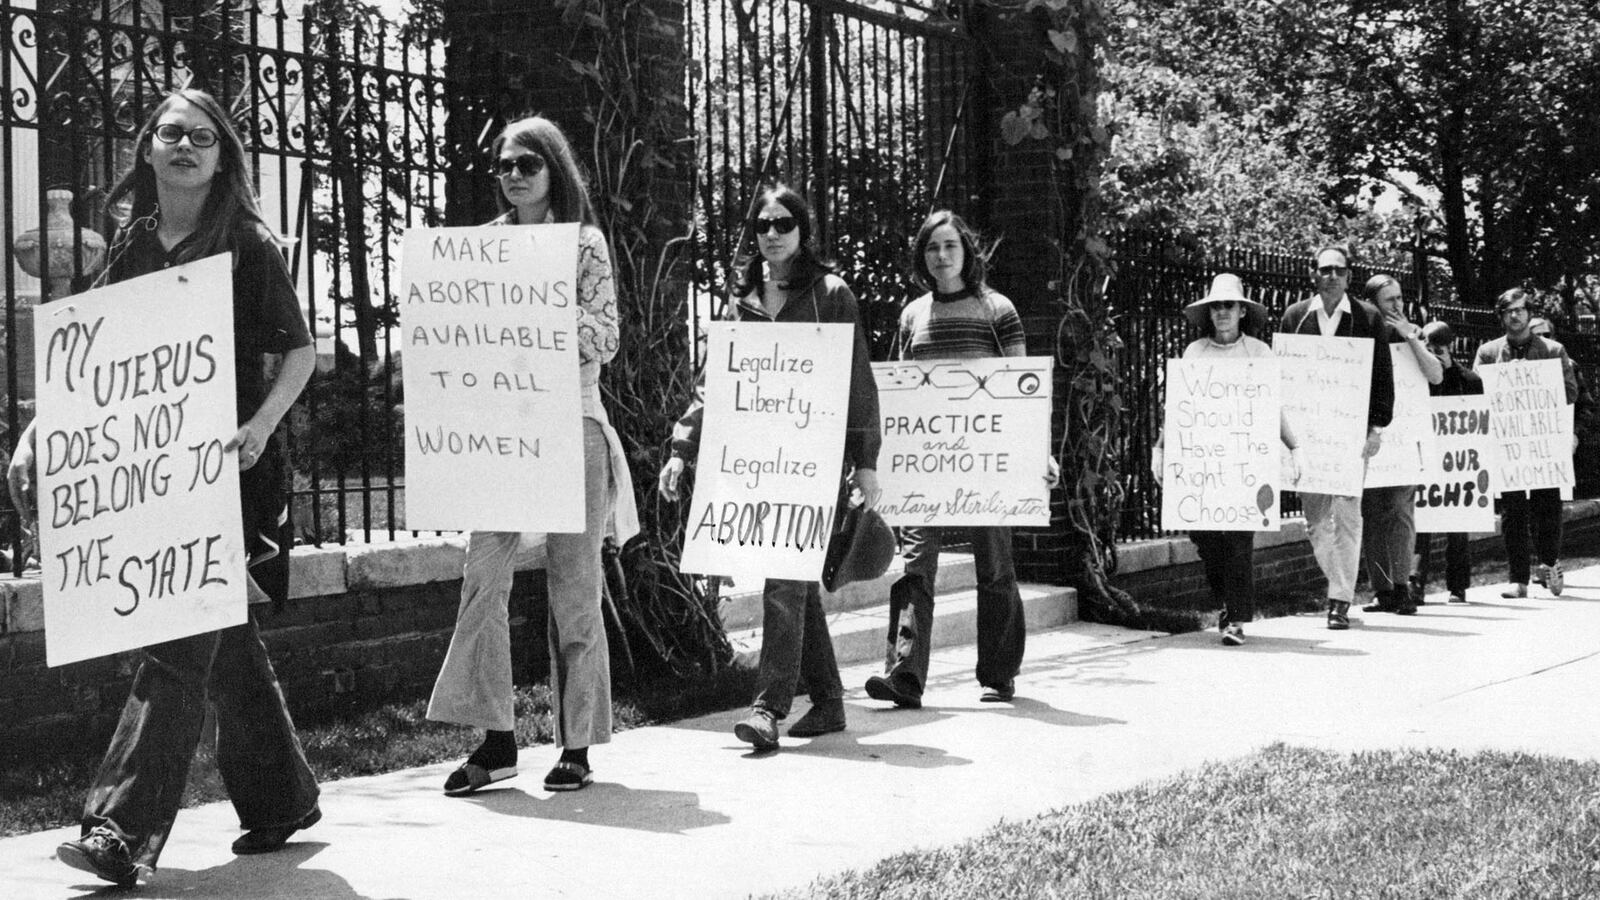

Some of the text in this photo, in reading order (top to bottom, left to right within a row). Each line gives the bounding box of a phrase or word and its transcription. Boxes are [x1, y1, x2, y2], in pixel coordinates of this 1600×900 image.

[432, 235, 511, 264] MAKE
[408, 279, 568, 308] ABORTIONS
[412, 324, 568, 351] AVAILABLE
[46, 316, 216, 407] MY UTERUS
[728, 341, 814, 383] Legalize
[1281, 368, 1295, 381] he
[430, 371, 551, 392] TO ALL
[1181, 365, 1271, 399] Women
[1498, 366, 1542, 388] MAKE
[735, 380, 835, 429] Liberty...
[1177, 399, 1254, 428] Should
[46, 393, 190, 476] DOES NOT
[884, 414, 1003, 436] PRACTICE
[1432, 409, 1489, 436] RTION
[415, 425, 540, 458] WOMEN
[922, 436, 969, 451] and
[1179, 431, 1269, 458] Have The
[1501, 440, 1552, 460] TO ALL
[720, 445, 817, 489] Legalize
[891, 453, 1009, 473] PROMOTE
[1443, 448, 1480, 472] OUR
[1502, 461, 1568, 487] WOMEN
[51, 438, 224, 529] BELONG TO
[1168, 461, 1257, 497] Right To
[1415, 469, 1489, 508] IGHT!
[872, 488, 1047, 523] luntary Sterilization
[692, 501, 833, 552] ABORTION
[56, 534, 228, 617] THE STATE
